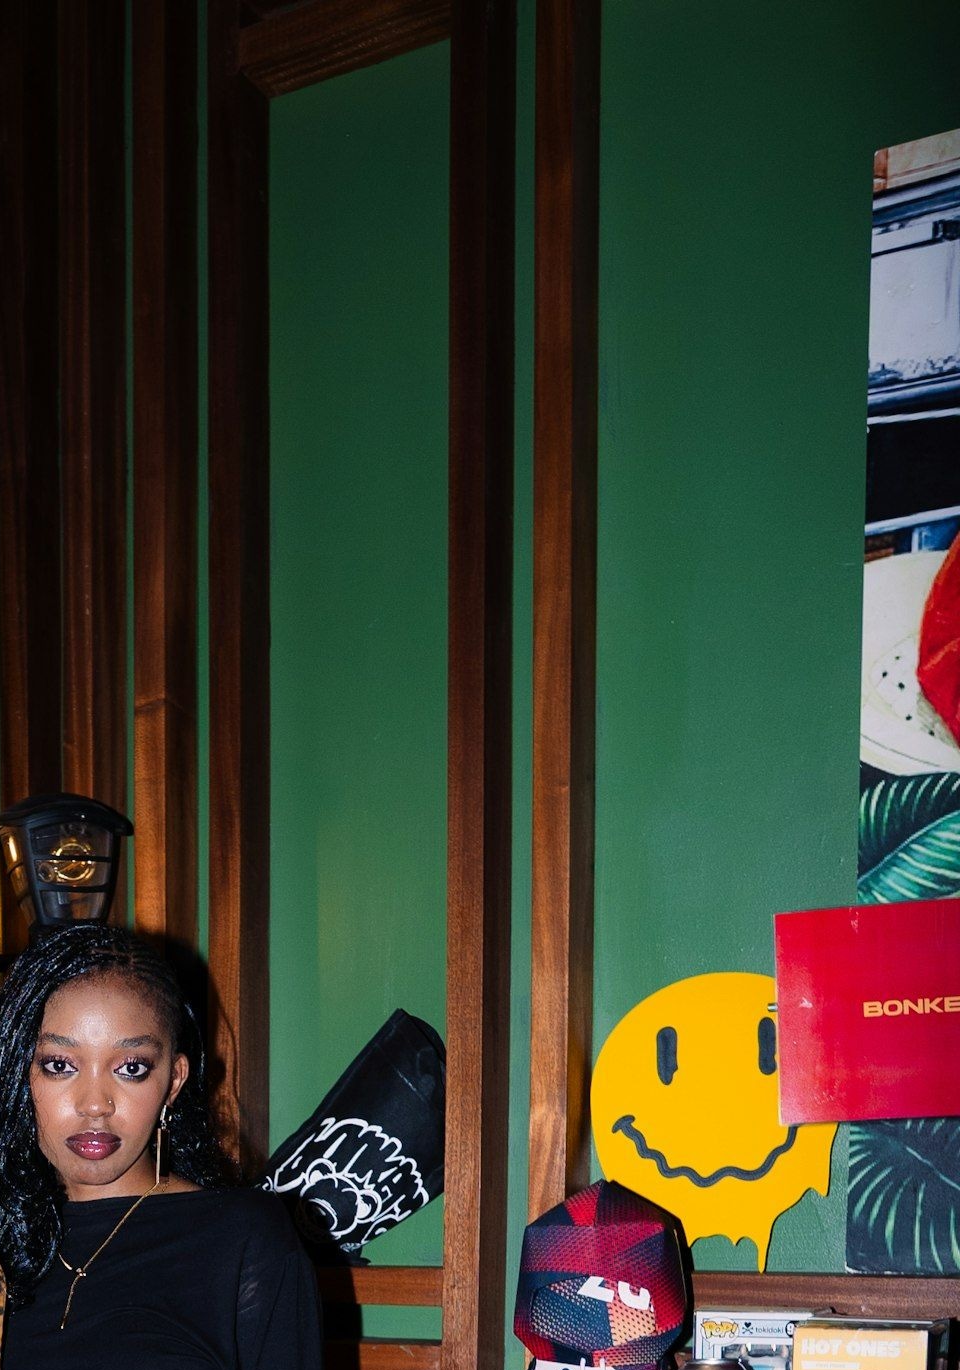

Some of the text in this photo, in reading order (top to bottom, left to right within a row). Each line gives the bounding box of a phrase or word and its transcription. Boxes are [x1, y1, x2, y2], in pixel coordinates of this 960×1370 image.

[701, 1320, 738, 1339] POP!
[755, 1326, 784, 1334] tokidoki
[801, 1338, 901, 1358] HOT ONES
